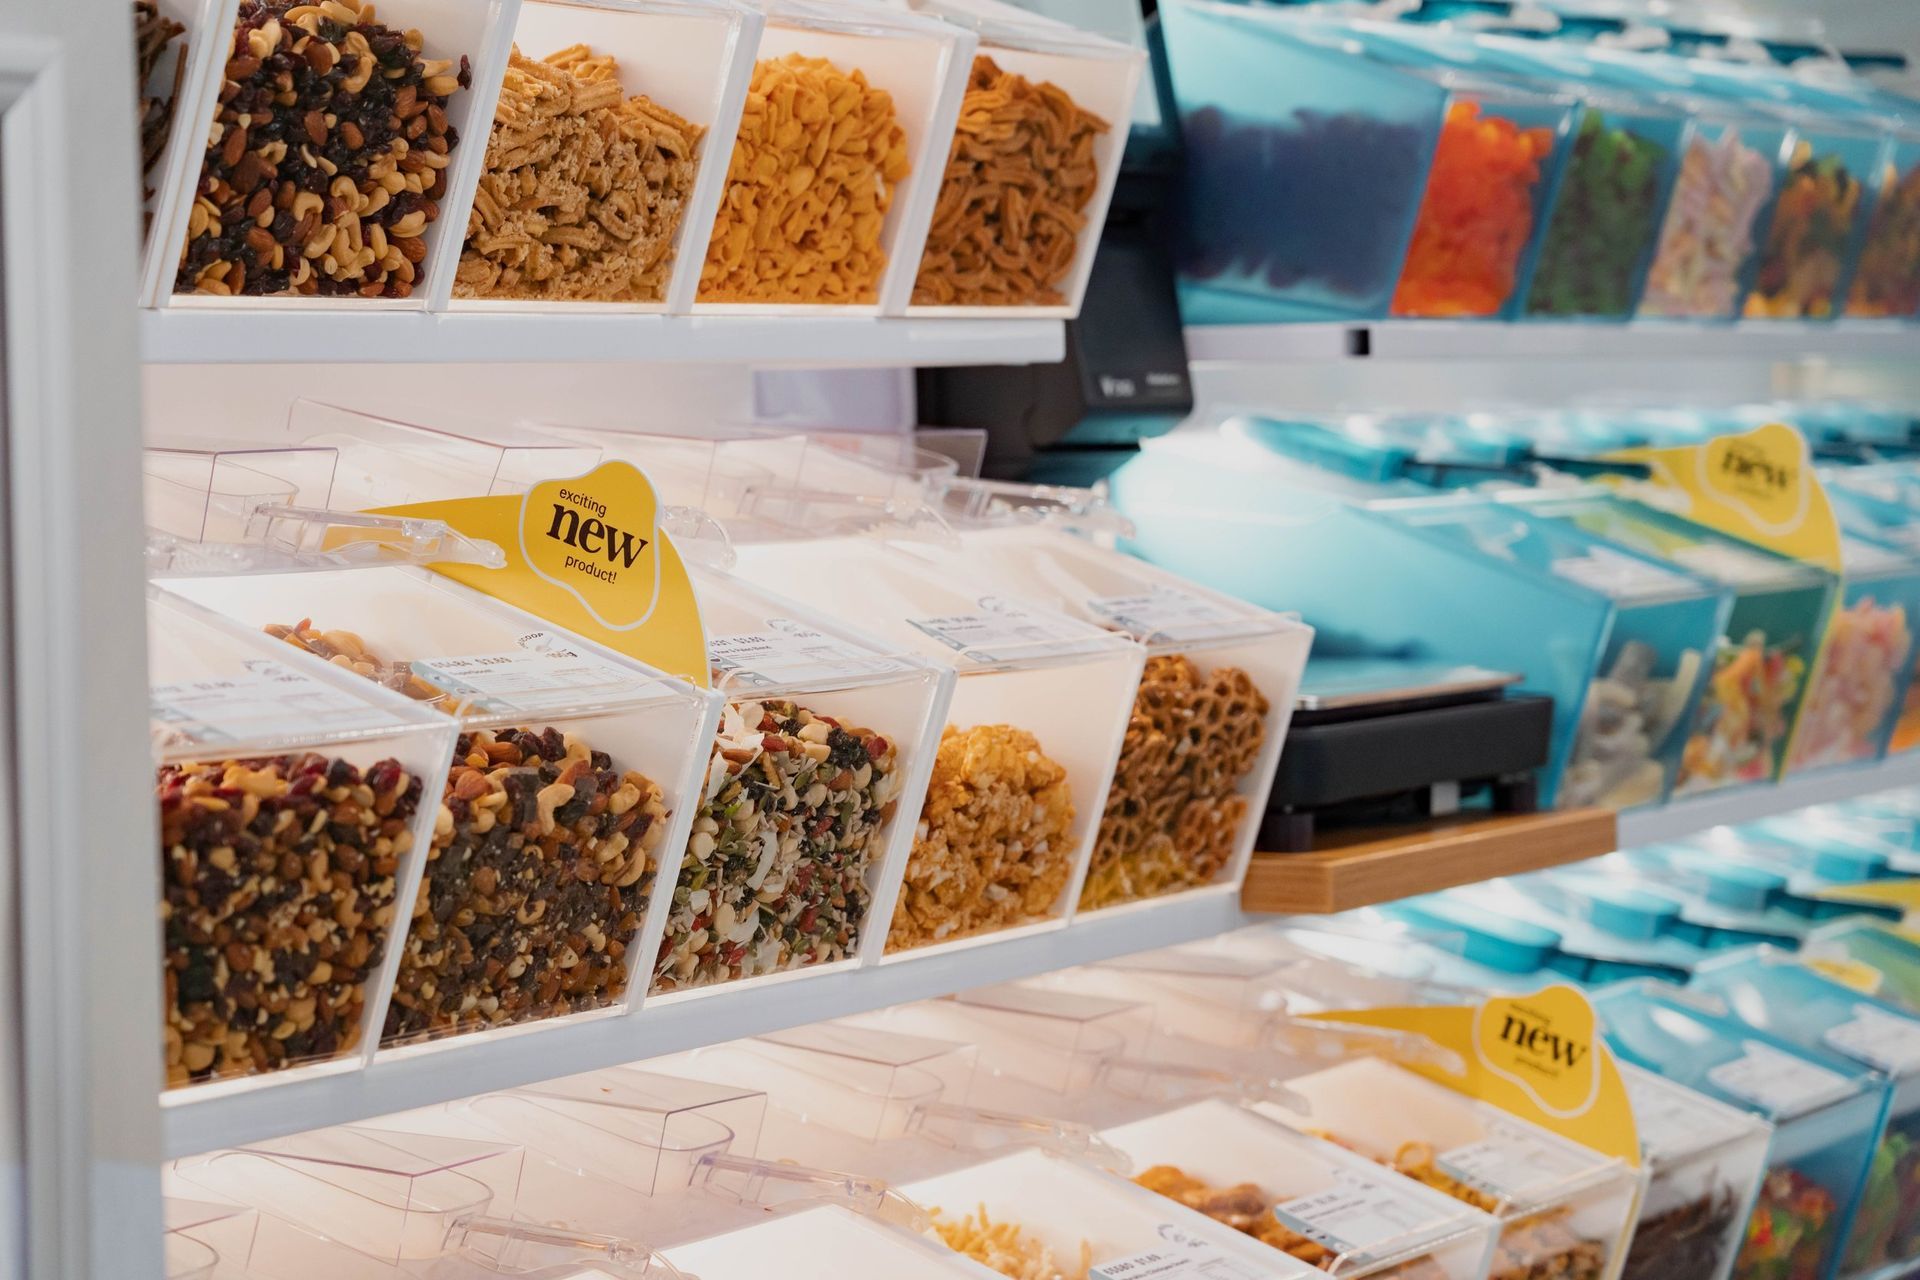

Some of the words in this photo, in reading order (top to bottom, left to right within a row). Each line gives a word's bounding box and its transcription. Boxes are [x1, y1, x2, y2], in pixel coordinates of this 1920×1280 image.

[559, 488, 607, 518] exciting
[546, 503, 649, 568] new
[564, 555, 617, 584] product!
[1500, 1014, 1587, 1068] new
